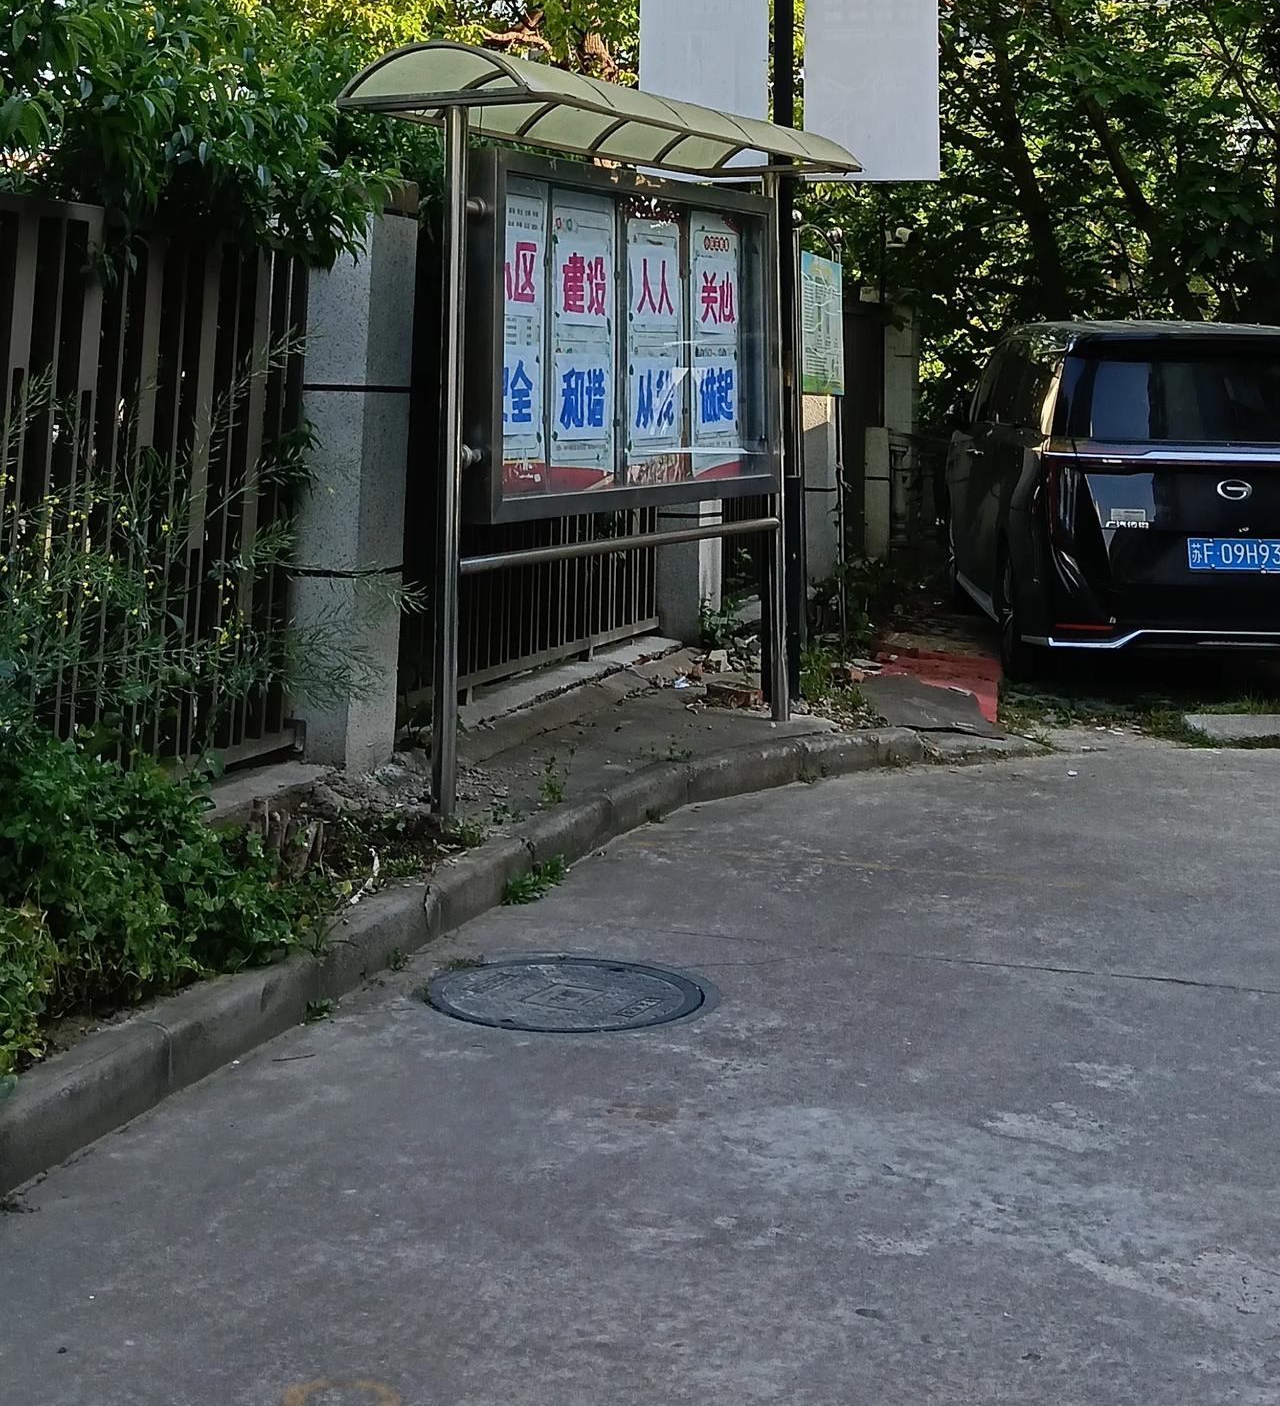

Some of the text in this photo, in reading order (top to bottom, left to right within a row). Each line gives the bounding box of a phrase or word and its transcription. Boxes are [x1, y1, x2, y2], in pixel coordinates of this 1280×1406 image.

[562, 252, 607, 316] 建设
[637, 258, 674, 316] 人人
[701, 271, 736, 325] 关心
[560, 367, 606, 430] 和谐
[699, 366, 734, 425] 做起
